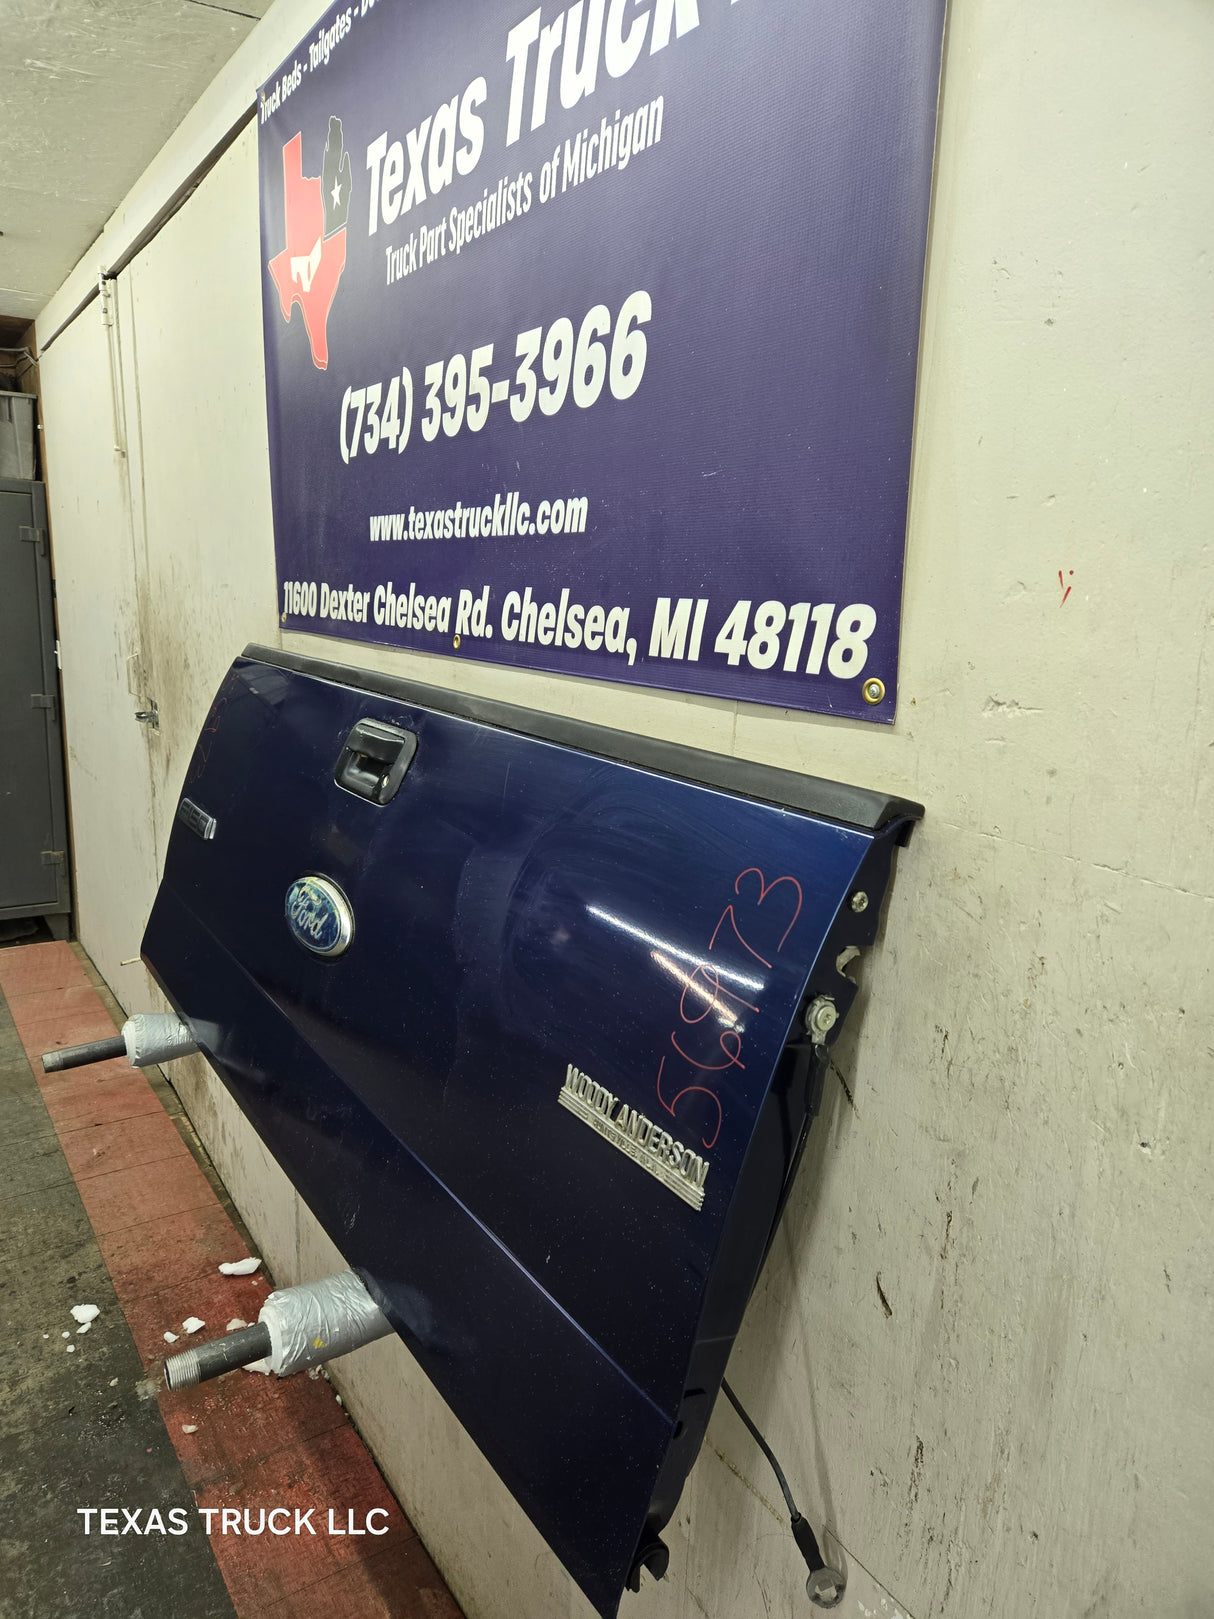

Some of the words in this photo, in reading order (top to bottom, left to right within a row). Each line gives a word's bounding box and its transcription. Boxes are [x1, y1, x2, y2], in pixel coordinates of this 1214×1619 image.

[260, 81, 281, 125] Truck
[281, 60, 302, 103] Beds
[309, 7, 352, 72] Tailgates
[366, 77, 487, 236] Texas
[385, 231, 418, 285] Truck
[419, 221, 447, 267] Part
[449, 171, 533, 254] Specialists
[539, 146, 561, 203] of
[562, 95, 664, 188] Michigan
[339, 366, 413, 464] (734)
[421, 290, 652, 442] 395-3966
[369, 492, 589, 541] www.texastruckllc.com
[283, 581, 317, 617] 11600
[320, 583, 371, 625] Dexter
[374, 581, 452, 633] Chelsea
[455, 585, 493, 638] Rd.
[501, 587, 638, 666] Chelsea,
[648, 597, 709, 661] MI
[714, 600, 877, 679] 48118
[290, 885, 326, 940] Ford
[564, 1063, 619, 1123] WOODY
[613, 1103, 710, 1188] ANDERSON
